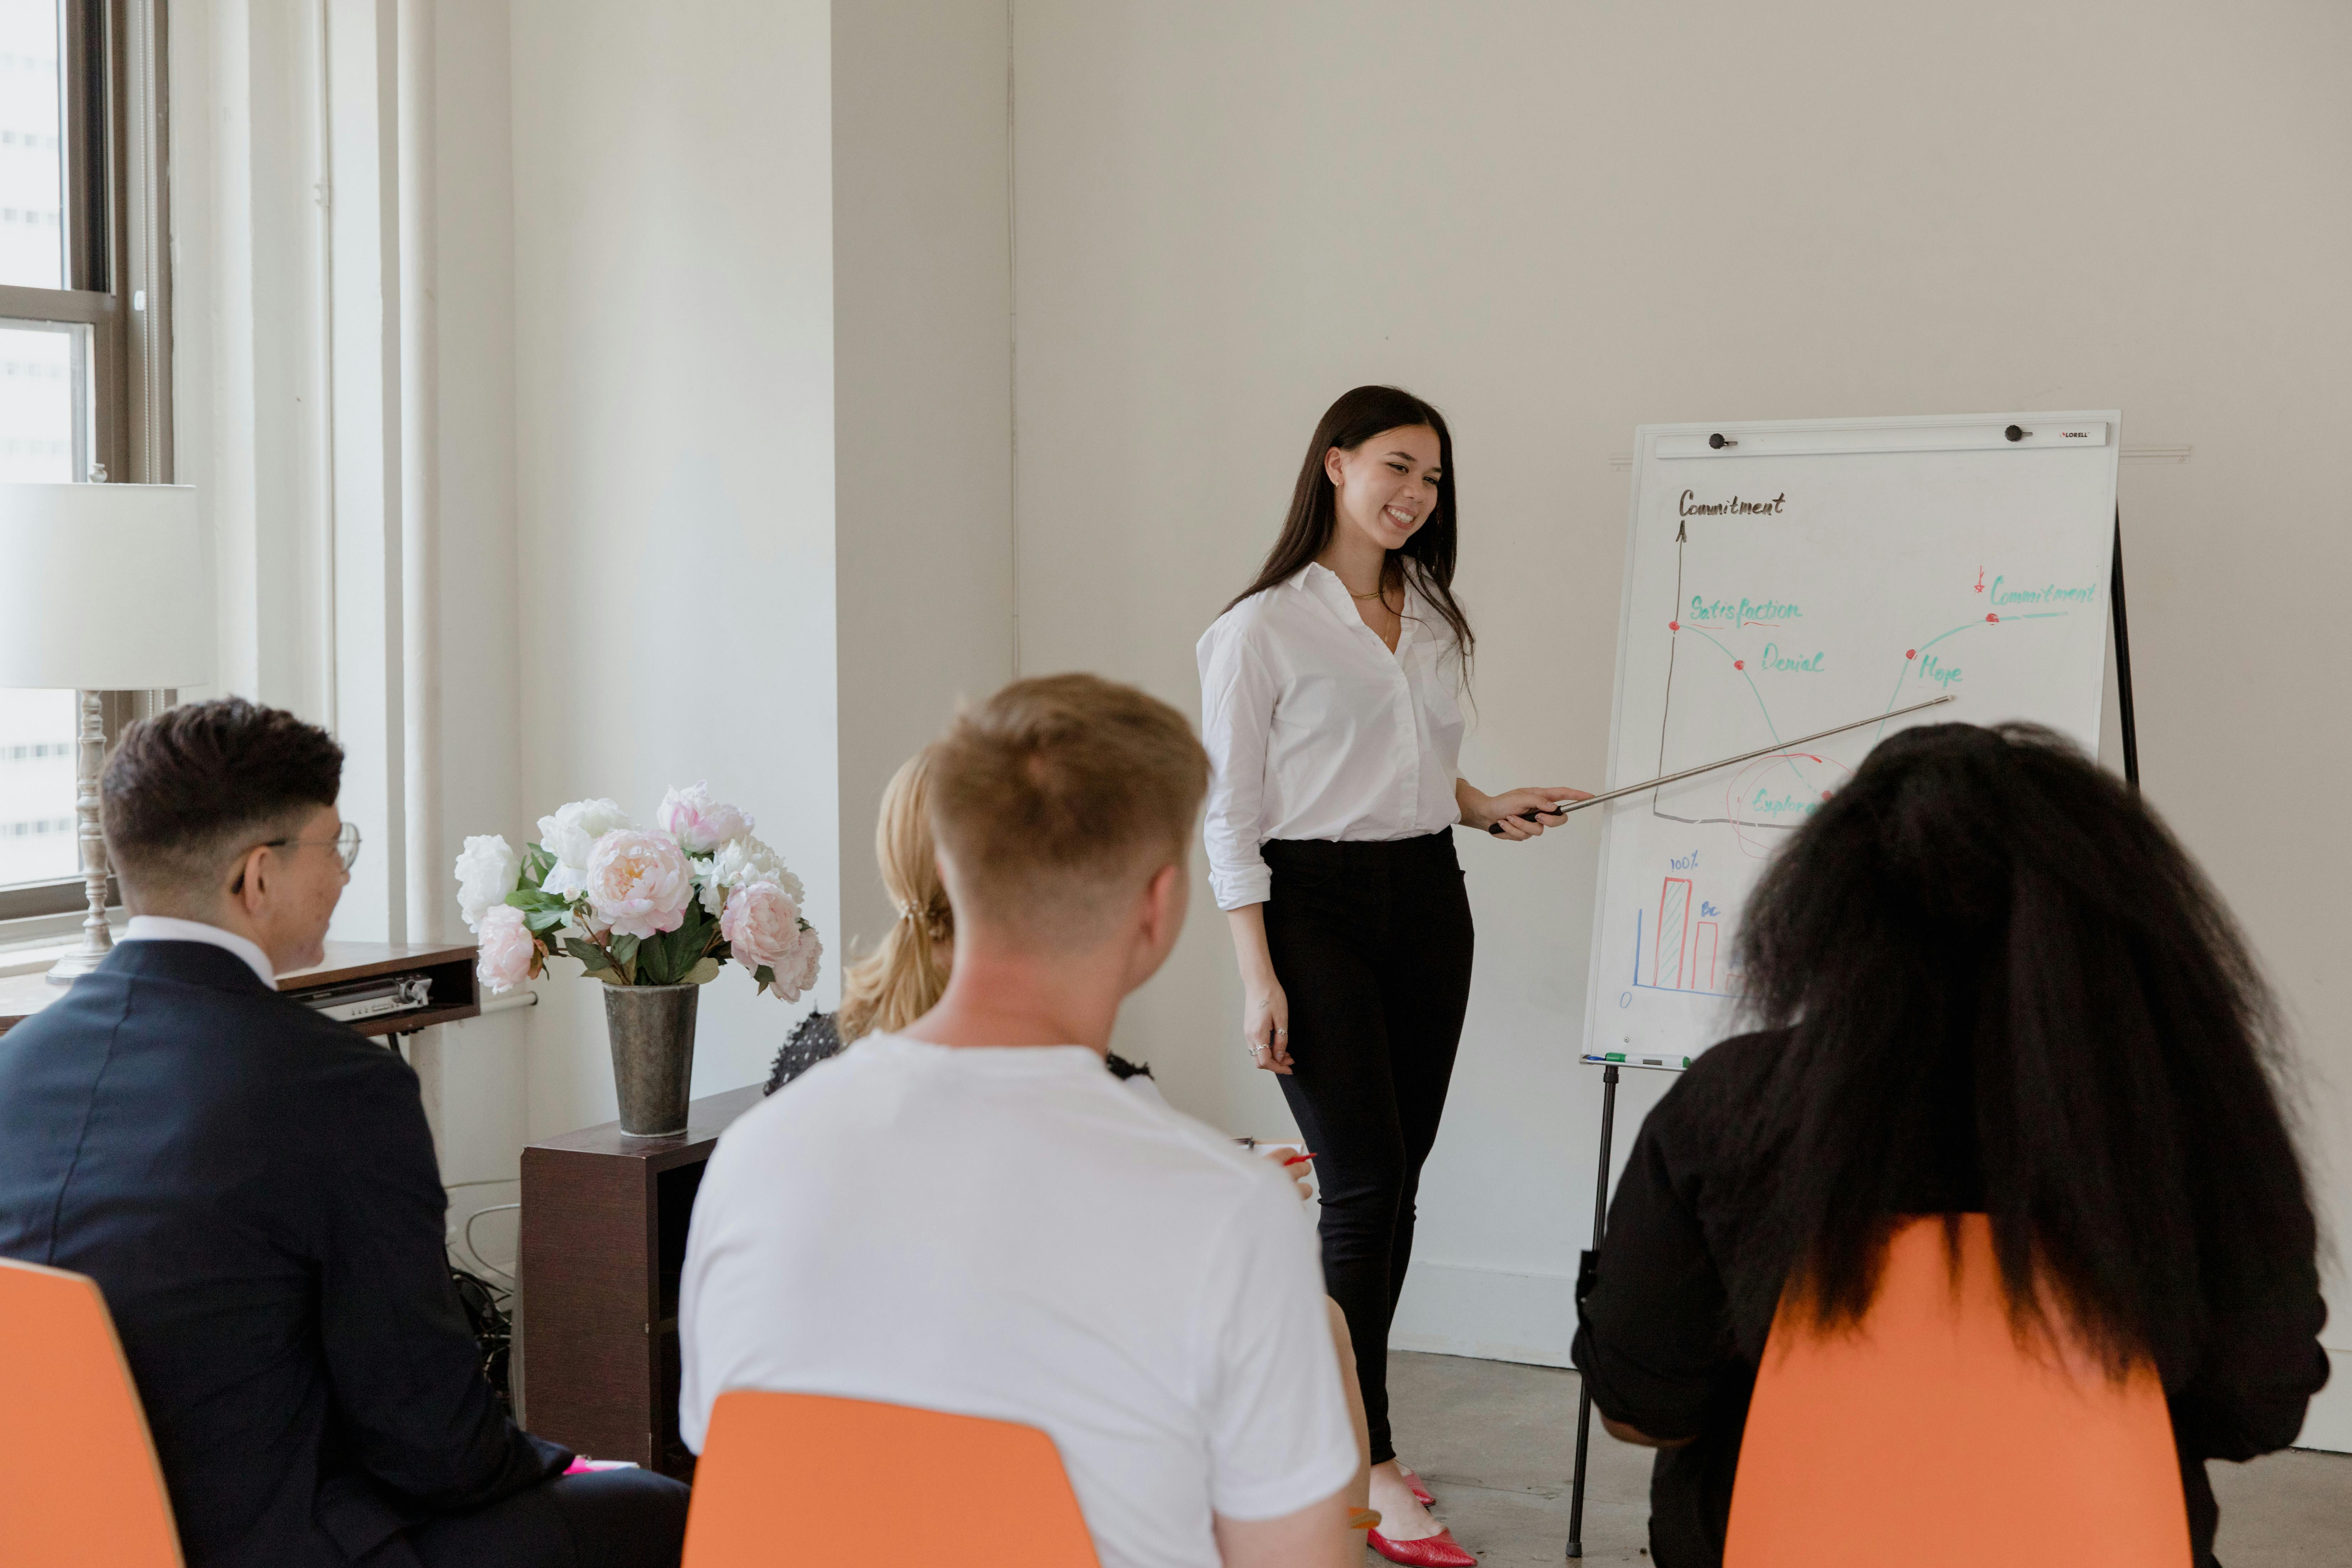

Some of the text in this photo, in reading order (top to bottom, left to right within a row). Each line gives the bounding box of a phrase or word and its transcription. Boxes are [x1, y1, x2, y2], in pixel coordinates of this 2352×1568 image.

[1679, 489, 1786, 517] Commitment
[1991, 575, 2096, 605] Commitment
[1690, 595, 1803, 629] Satisfaction
[1761, 642, 1825, 673] Denial
[1919, 654, 1963, 689] Hope
[1670, 849, 1698, 872] 100%
